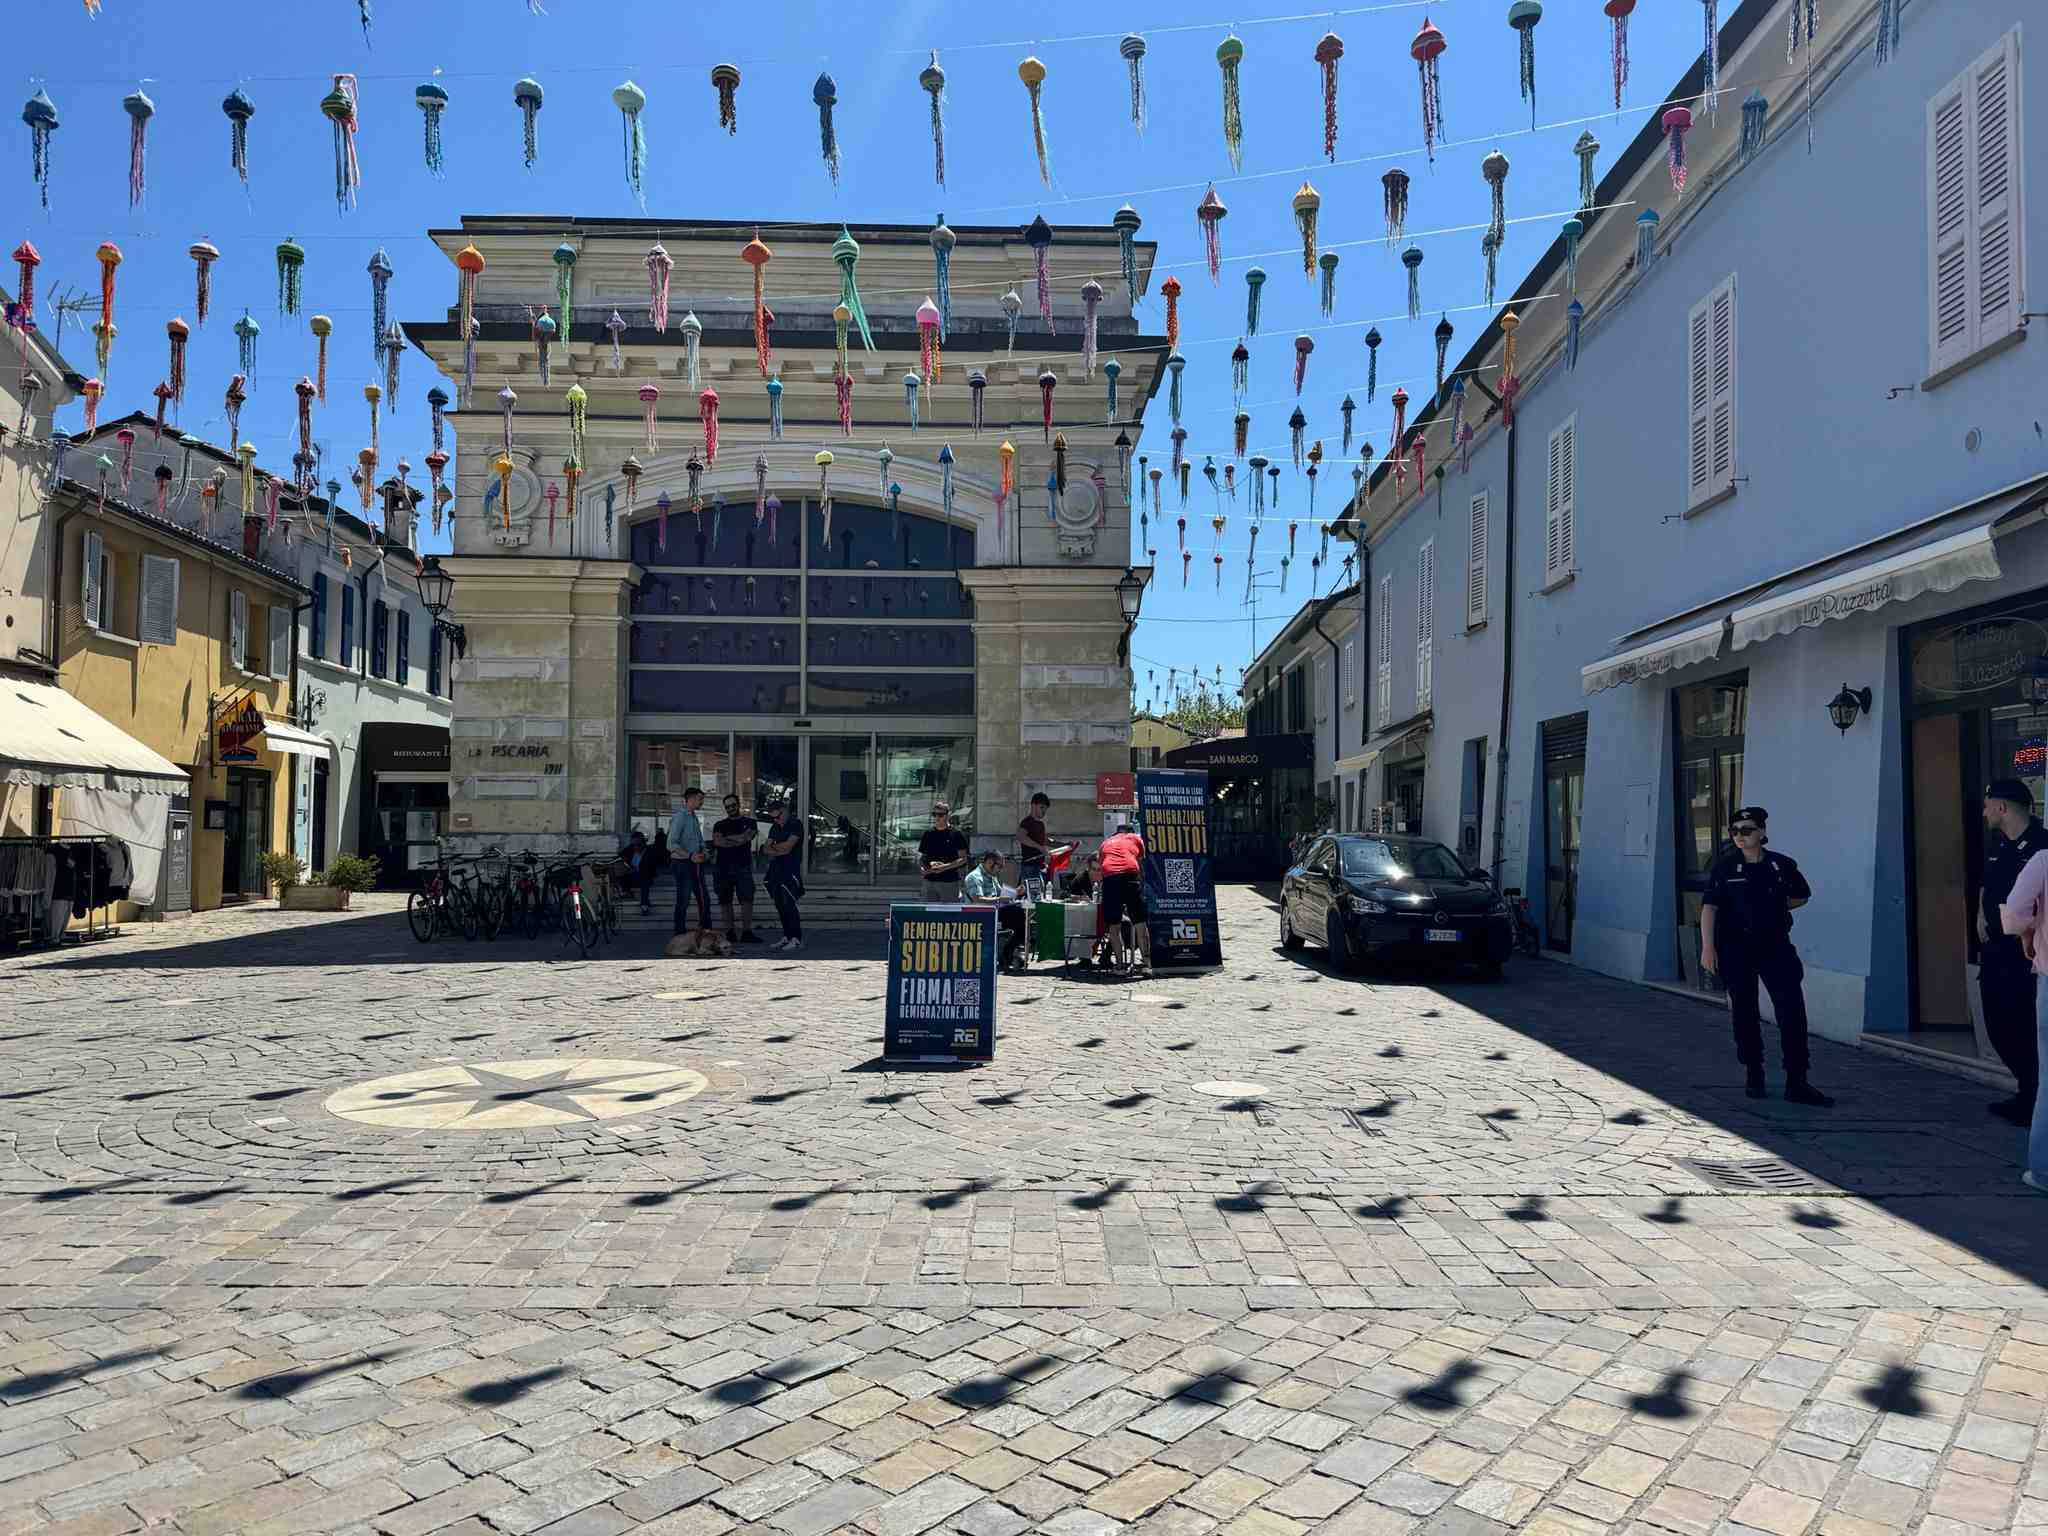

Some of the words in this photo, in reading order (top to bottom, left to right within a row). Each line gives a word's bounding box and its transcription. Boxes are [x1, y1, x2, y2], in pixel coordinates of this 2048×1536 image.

[1821, 582, 1890, 617] Piazzetta
[1208, 754, 1226, 765] SAN
[1227, 754, 1259, 765] MARCO
[1145, 808, 1206, 826] REMIGRAZIONE
[1148, 825, 1208, 853] SUBITO!
[903, 922, 983, 940] REMIGRAZIONE
[901, 940, 982, 973] SUBITO!
[899, 977, 953, 1005] FIRMA
[899, 1005, 980, 1020] REMIGRAZIONE.ORG
